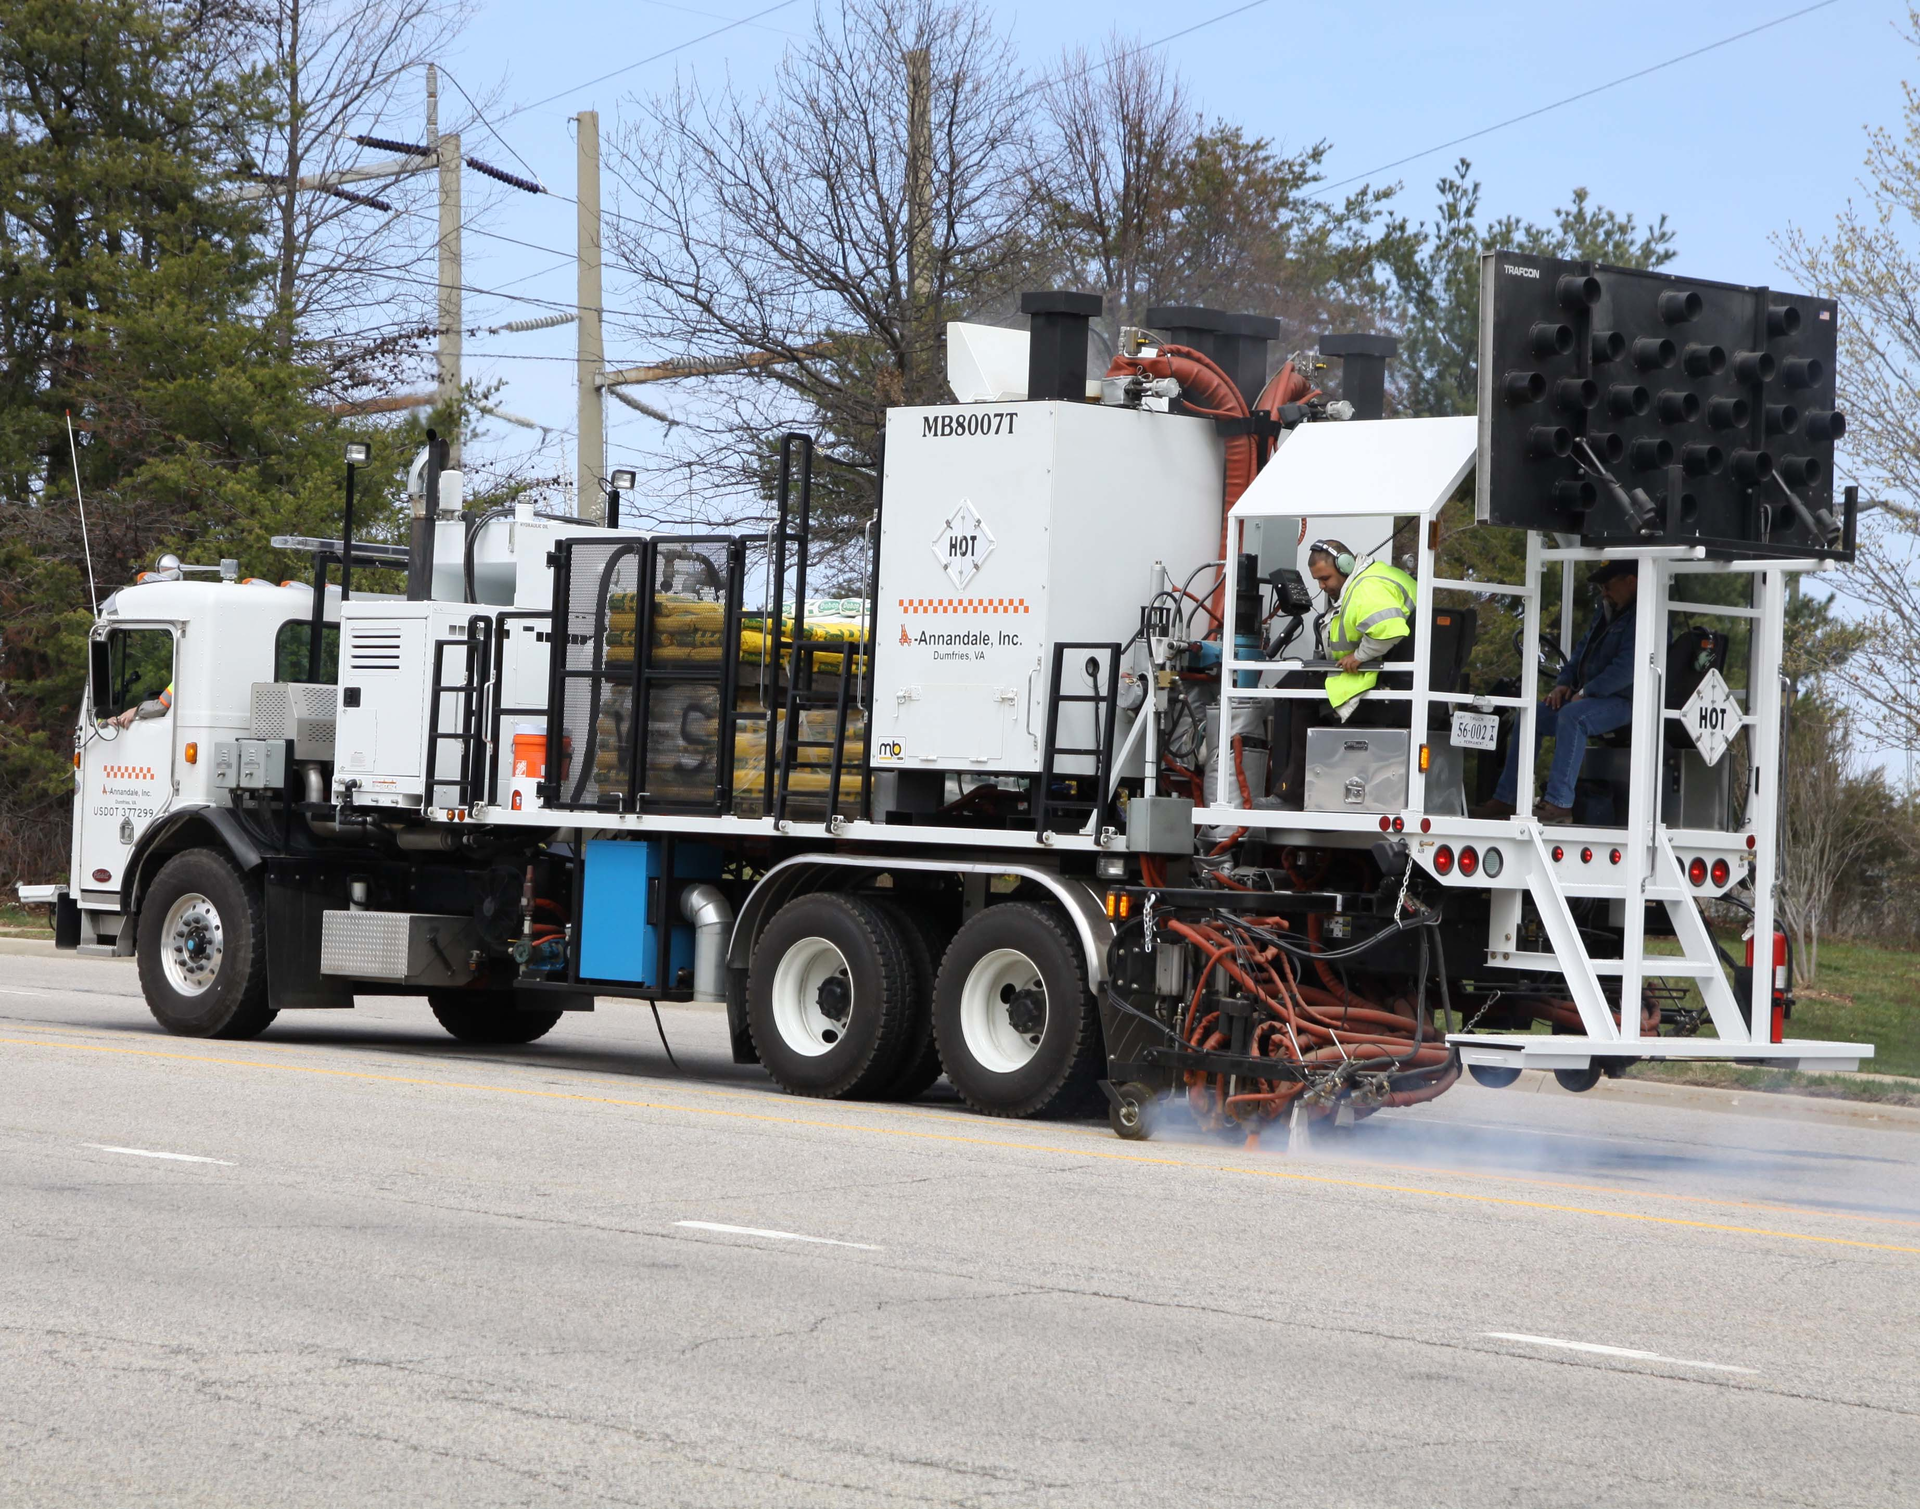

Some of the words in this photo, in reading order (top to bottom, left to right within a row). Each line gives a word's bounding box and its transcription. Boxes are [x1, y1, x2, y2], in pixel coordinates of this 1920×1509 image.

[1503, 264, 1540, 279] TRAFCON
[922, 412, 1018, 437] MB8007T
[949, 535, 977, 557] HOT
[999, 630, 1023, 646] Inc.
[933, 650, 972, 662] Dumfries,
[974, 650, 985, 661] VA
[1699, 706, 1727, 731] HOT
[141, 789, 153, 797] Inc.
[93, 806, 119, 817] USDOT
[121, 807, 154, 818] 377299
